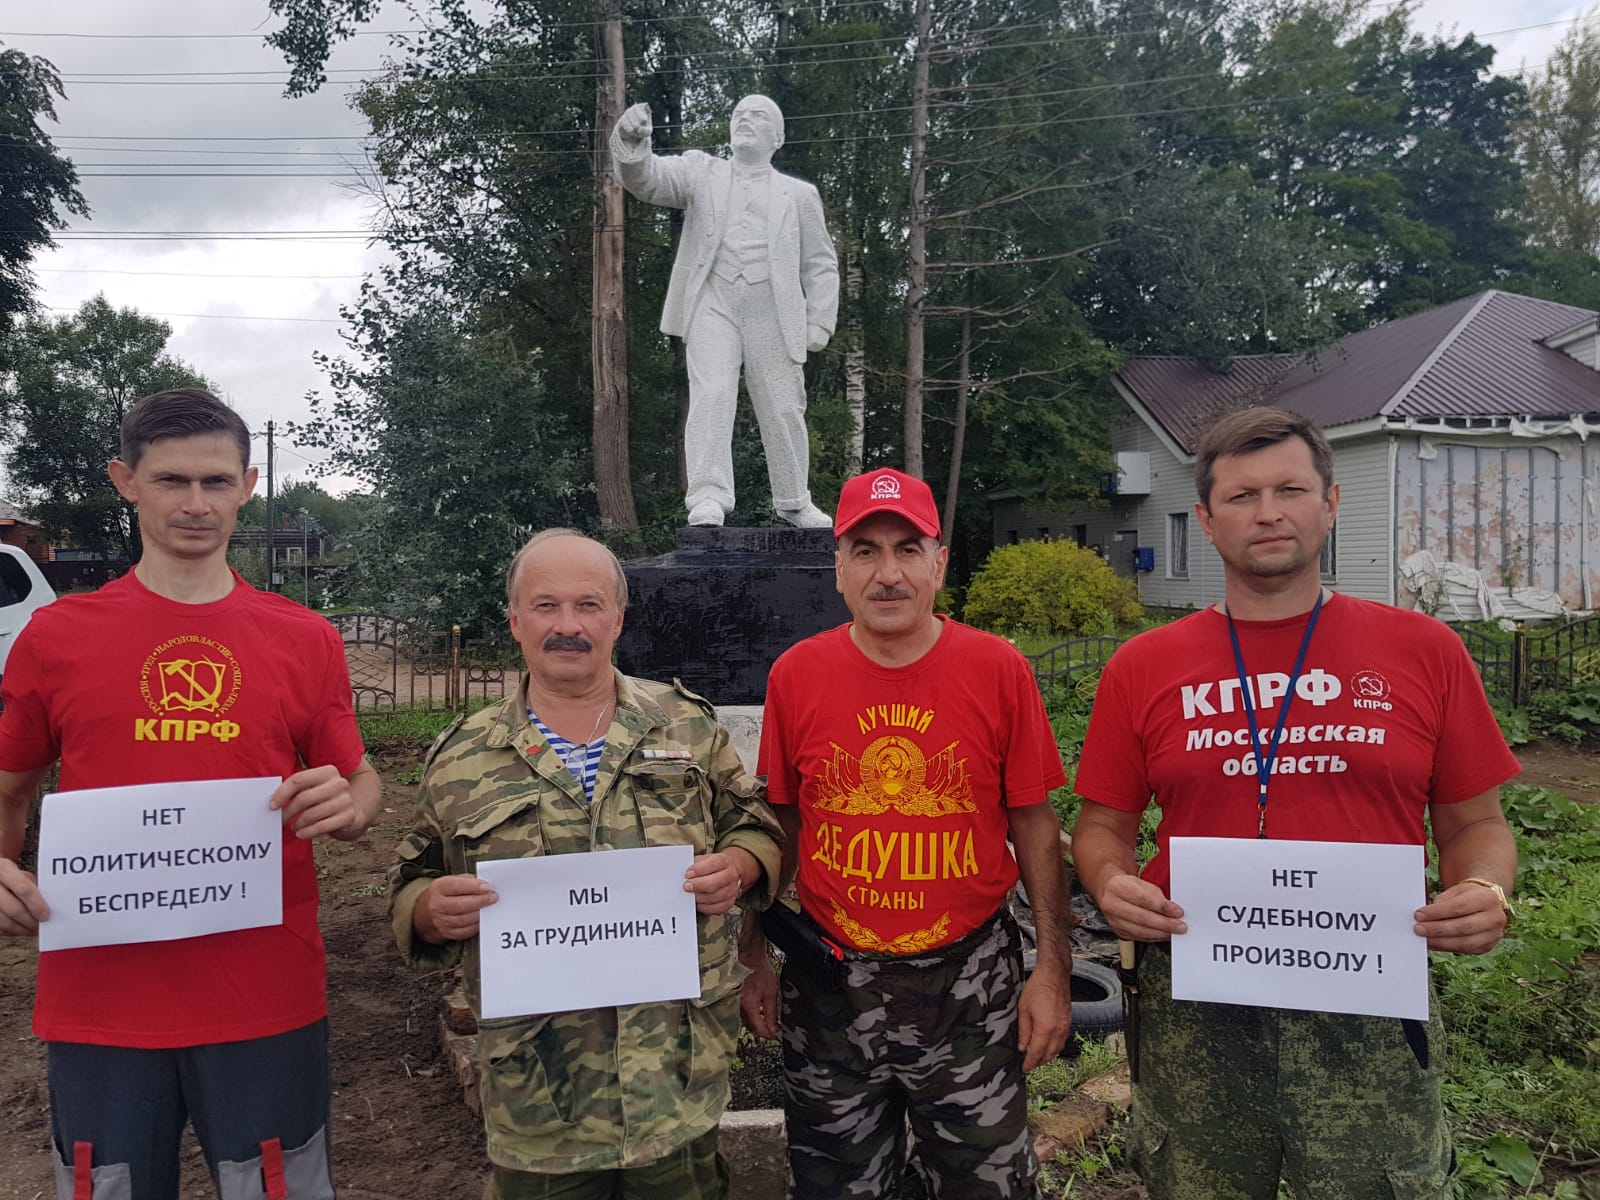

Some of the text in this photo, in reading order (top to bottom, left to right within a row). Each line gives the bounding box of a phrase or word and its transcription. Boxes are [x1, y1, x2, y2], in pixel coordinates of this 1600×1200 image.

[1181, 668, 1342, 720] КПРФ
[1353, 698, 1393, 711] КПРФ
[134, 718, 241, 742] КПРФ
[856, 703, 935, 735] ЛУЧШИЙ
[142, 808, 186, 826] НЕТ
[52, 842, 272, 875] ПОЛИТИЧЕСКОМУ
[811, 821, 980, 883] ДЕДУШКА
[1272, 869, 1318, 889] НЕТ
[79, 884, 233, 914] БЕСПРЕДЕЛУ
[569, 886, 609, 906] МЫ
[847, 885, 925, 910] СТРАНЫ
[1217, 905, 1377, 932] СУДЕБНОМУ
[500, 931, 528, 949] ЗА
[534, 918, 665, 947] ГРУДИНИНА
[1212, 943, 1368, 973] ПРОИЗВОЛУ
